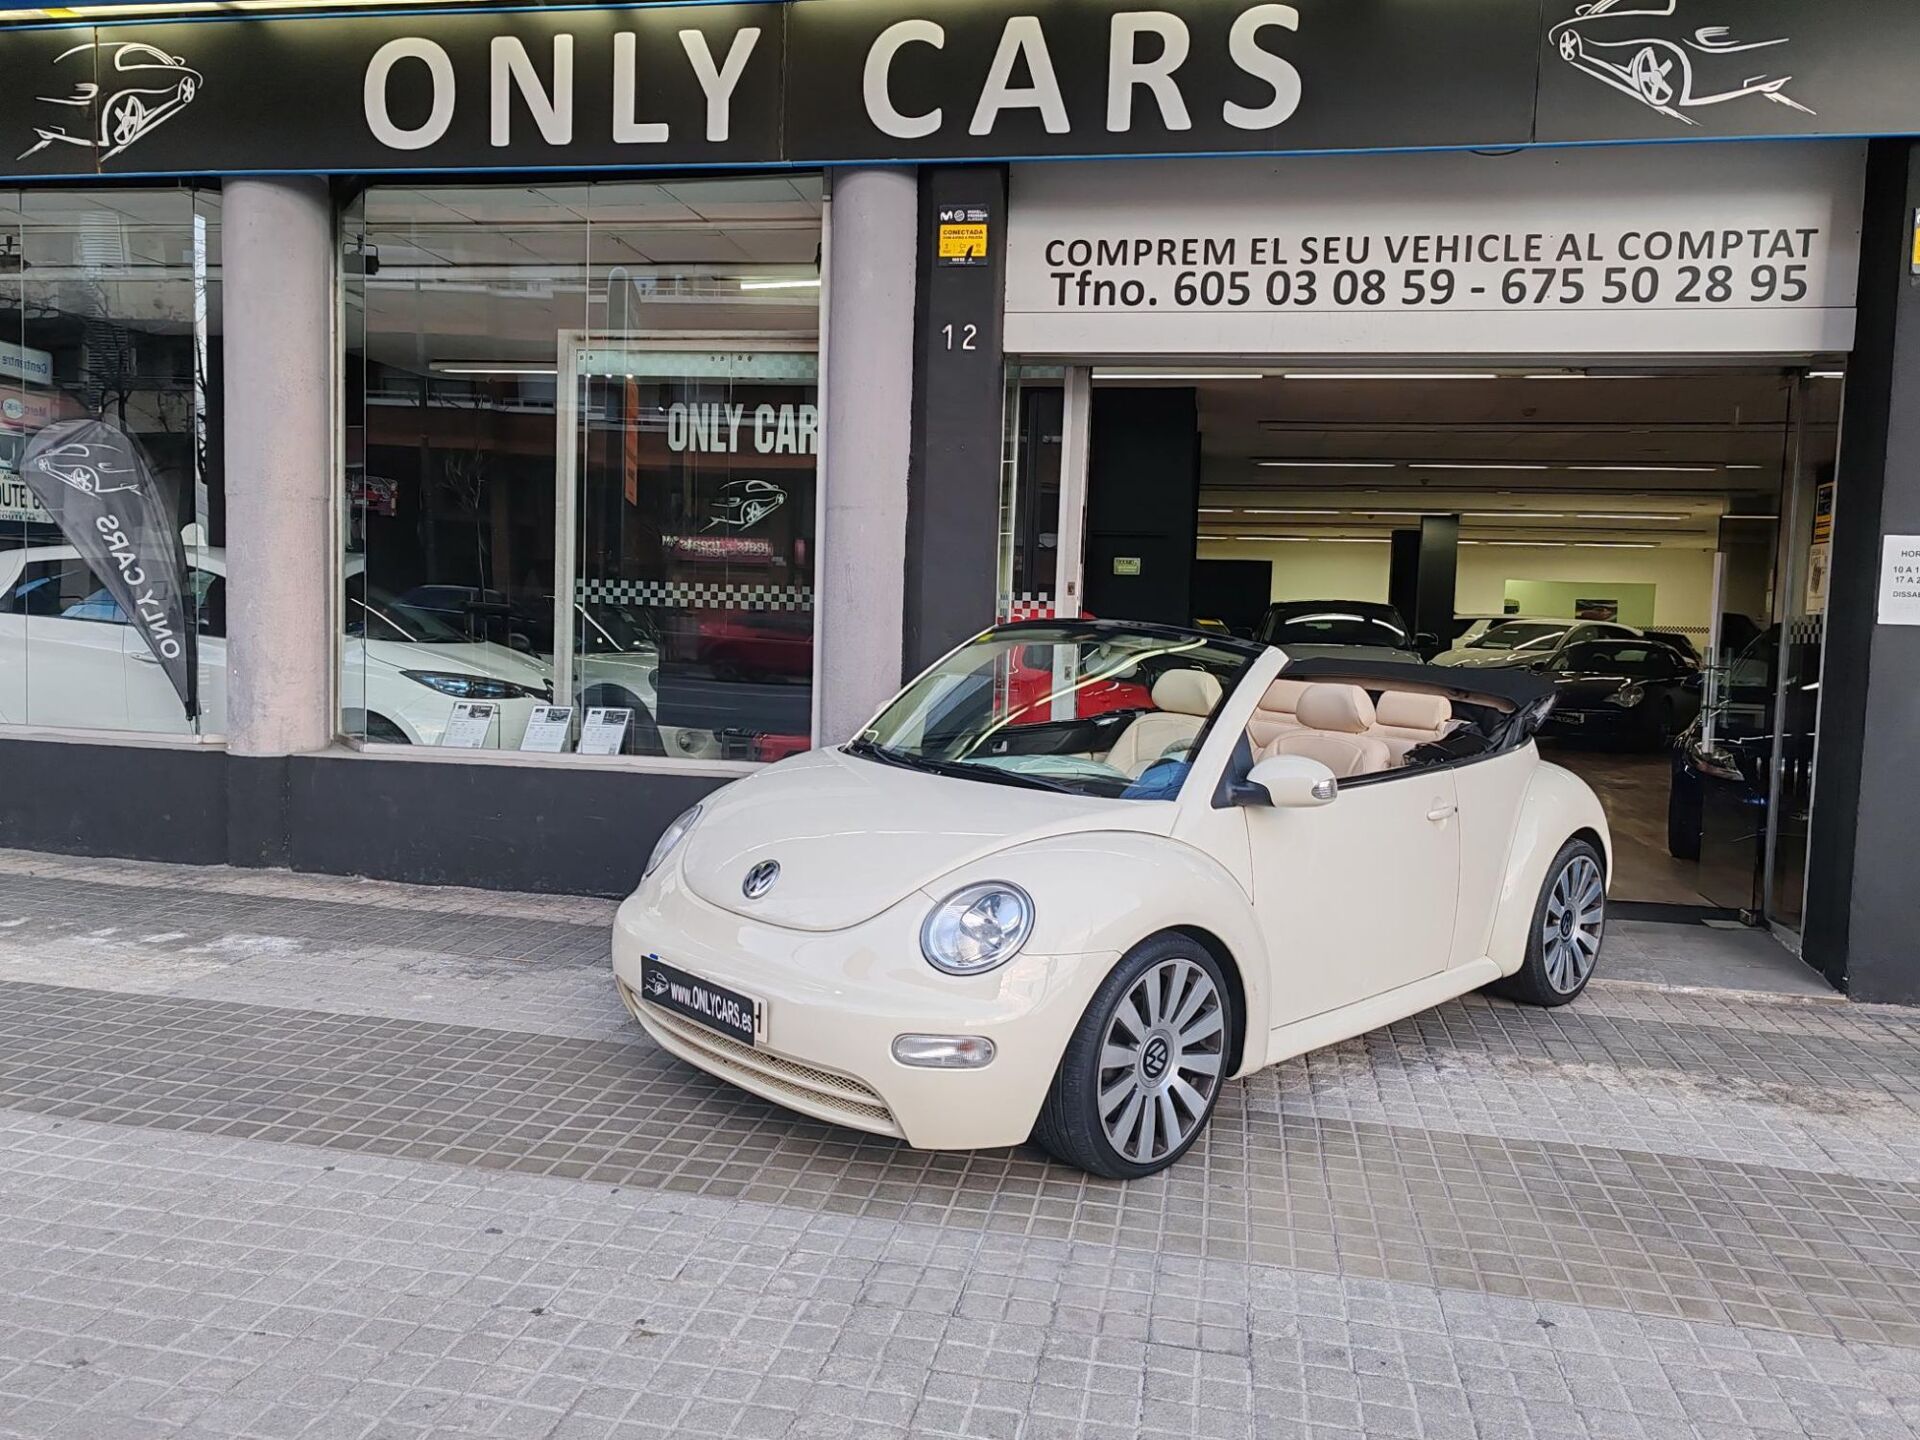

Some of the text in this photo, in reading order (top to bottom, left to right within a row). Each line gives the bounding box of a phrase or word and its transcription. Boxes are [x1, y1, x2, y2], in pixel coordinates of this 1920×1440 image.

[364, 3, 1302, 150] ONLY CARS
[1045, 229, 1819, 266] COMPREM EL SEU VEHICLE AL COMPTAT
[1050, 270, 1157, 306] Tfno.
[1174, 271, 1250, 306] 605
[1266, 270, 1317, 305] 03
[1333, 269, 1386, 305] 08
[1401, 269, 1455, 305] 59
[1501, 268, 1585, 304] 675
[1601, 266, 1659, 304] 50
[1675, 265, 1733, 303] 28
[1750, 264, 1808, 302] 95
[942, 324, 977, 350] 12
[668, 402, 744, 453] ONLY
[670, 981, 752, 1034] www.ONLYCARS.es
